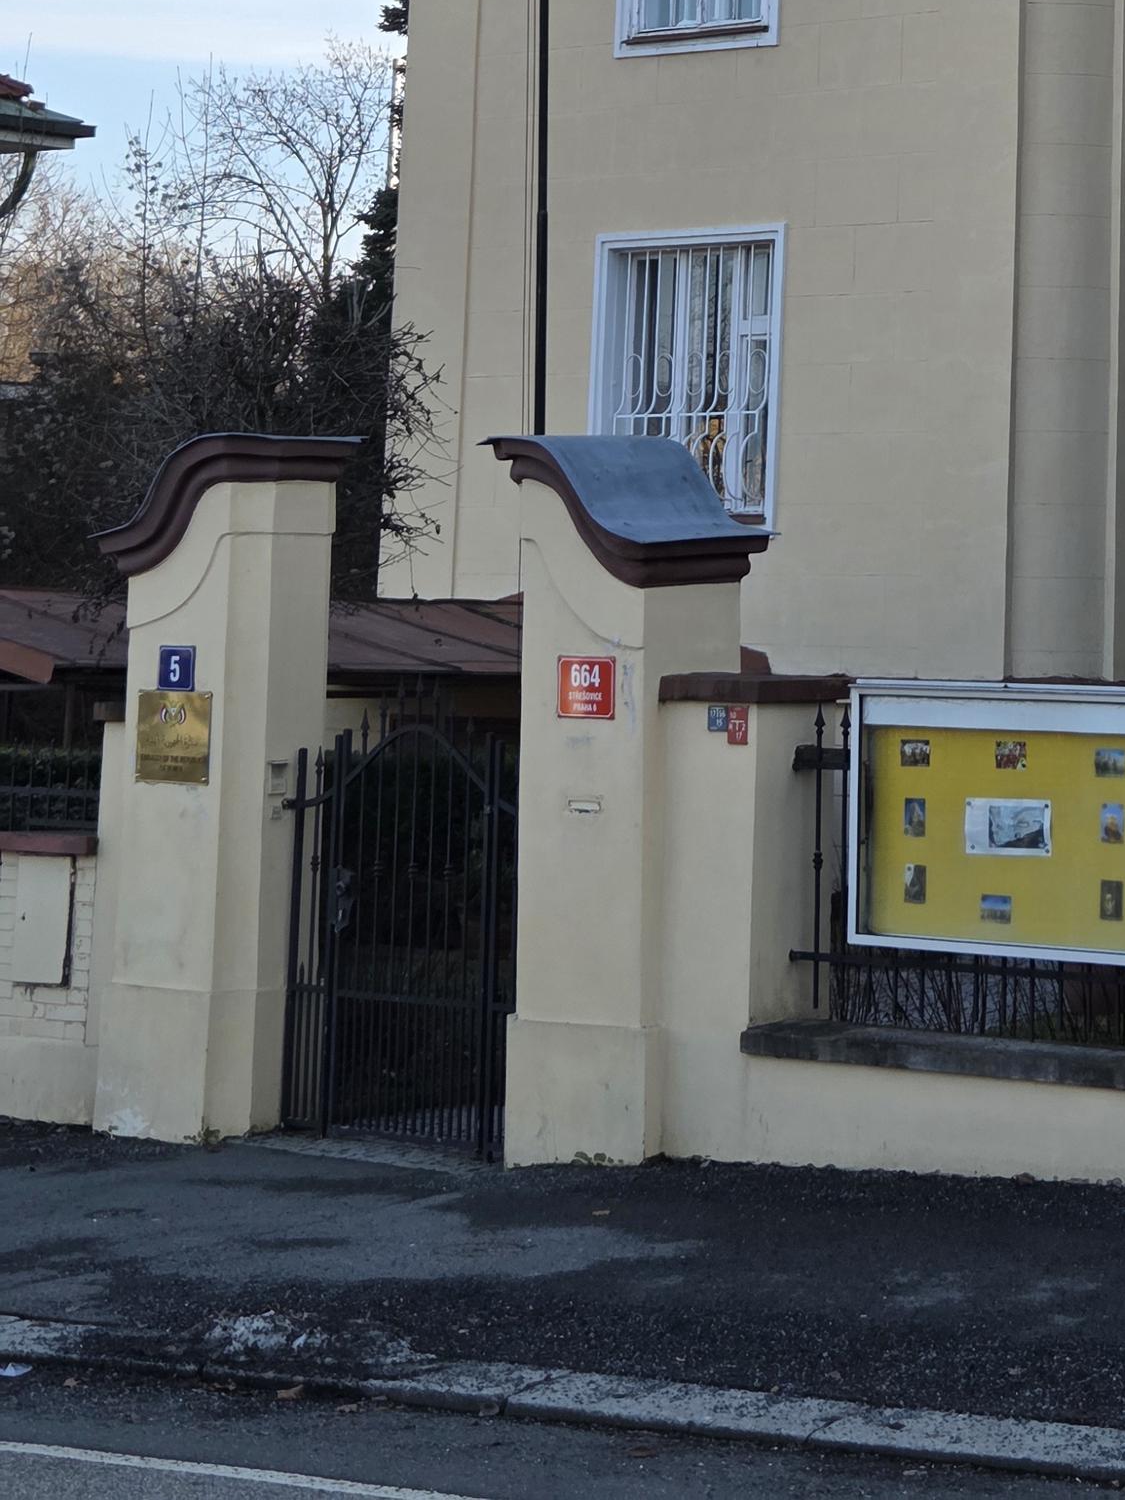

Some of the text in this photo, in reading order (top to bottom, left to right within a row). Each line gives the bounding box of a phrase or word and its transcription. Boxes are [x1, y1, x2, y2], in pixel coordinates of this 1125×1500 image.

[170, 655, 180, 682] 5
[571, 664, 600, 687] 664
[573, 702, 592, 711] PRAHA
